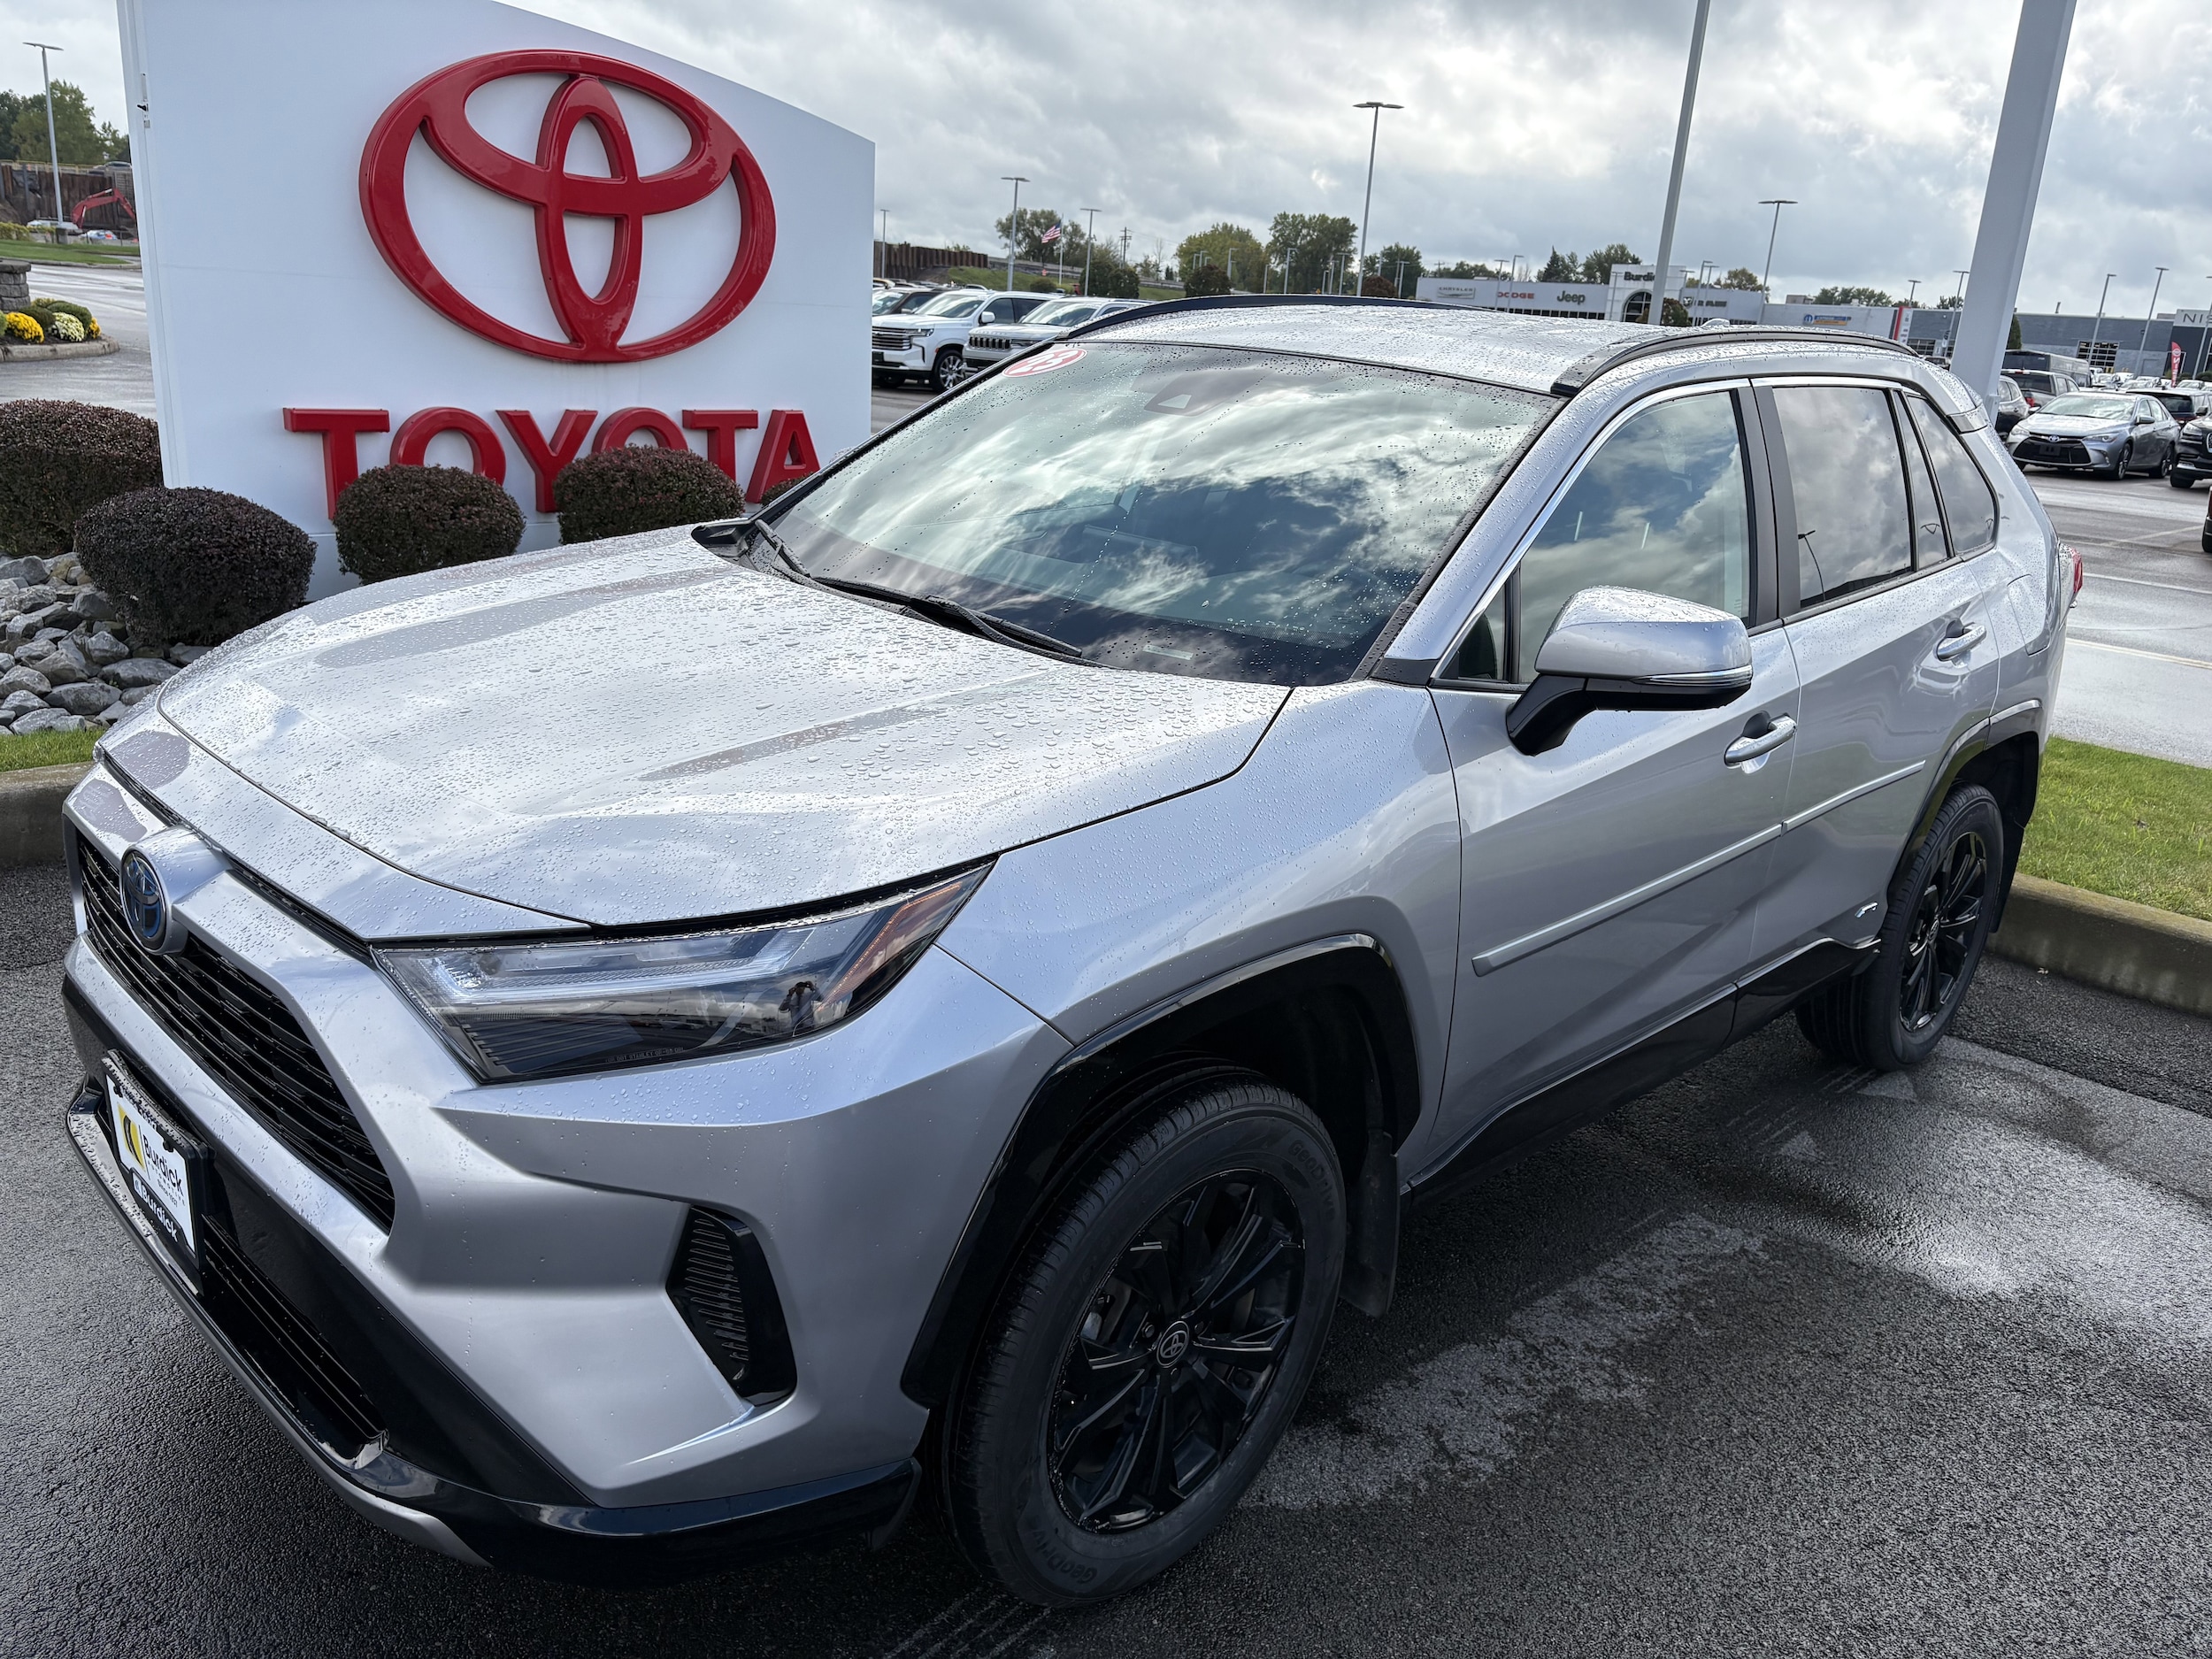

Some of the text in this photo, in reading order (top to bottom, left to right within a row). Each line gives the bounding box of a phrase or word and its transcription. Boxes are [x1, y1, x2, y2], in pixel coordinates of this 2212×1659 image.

[1624, 272, 1655, 281] Burdi
[1556, 290, 1586, 305] Jeep
[142, 1134, 184, 1197] Burdick
[141, 1185, 179, 1242] Burdick
